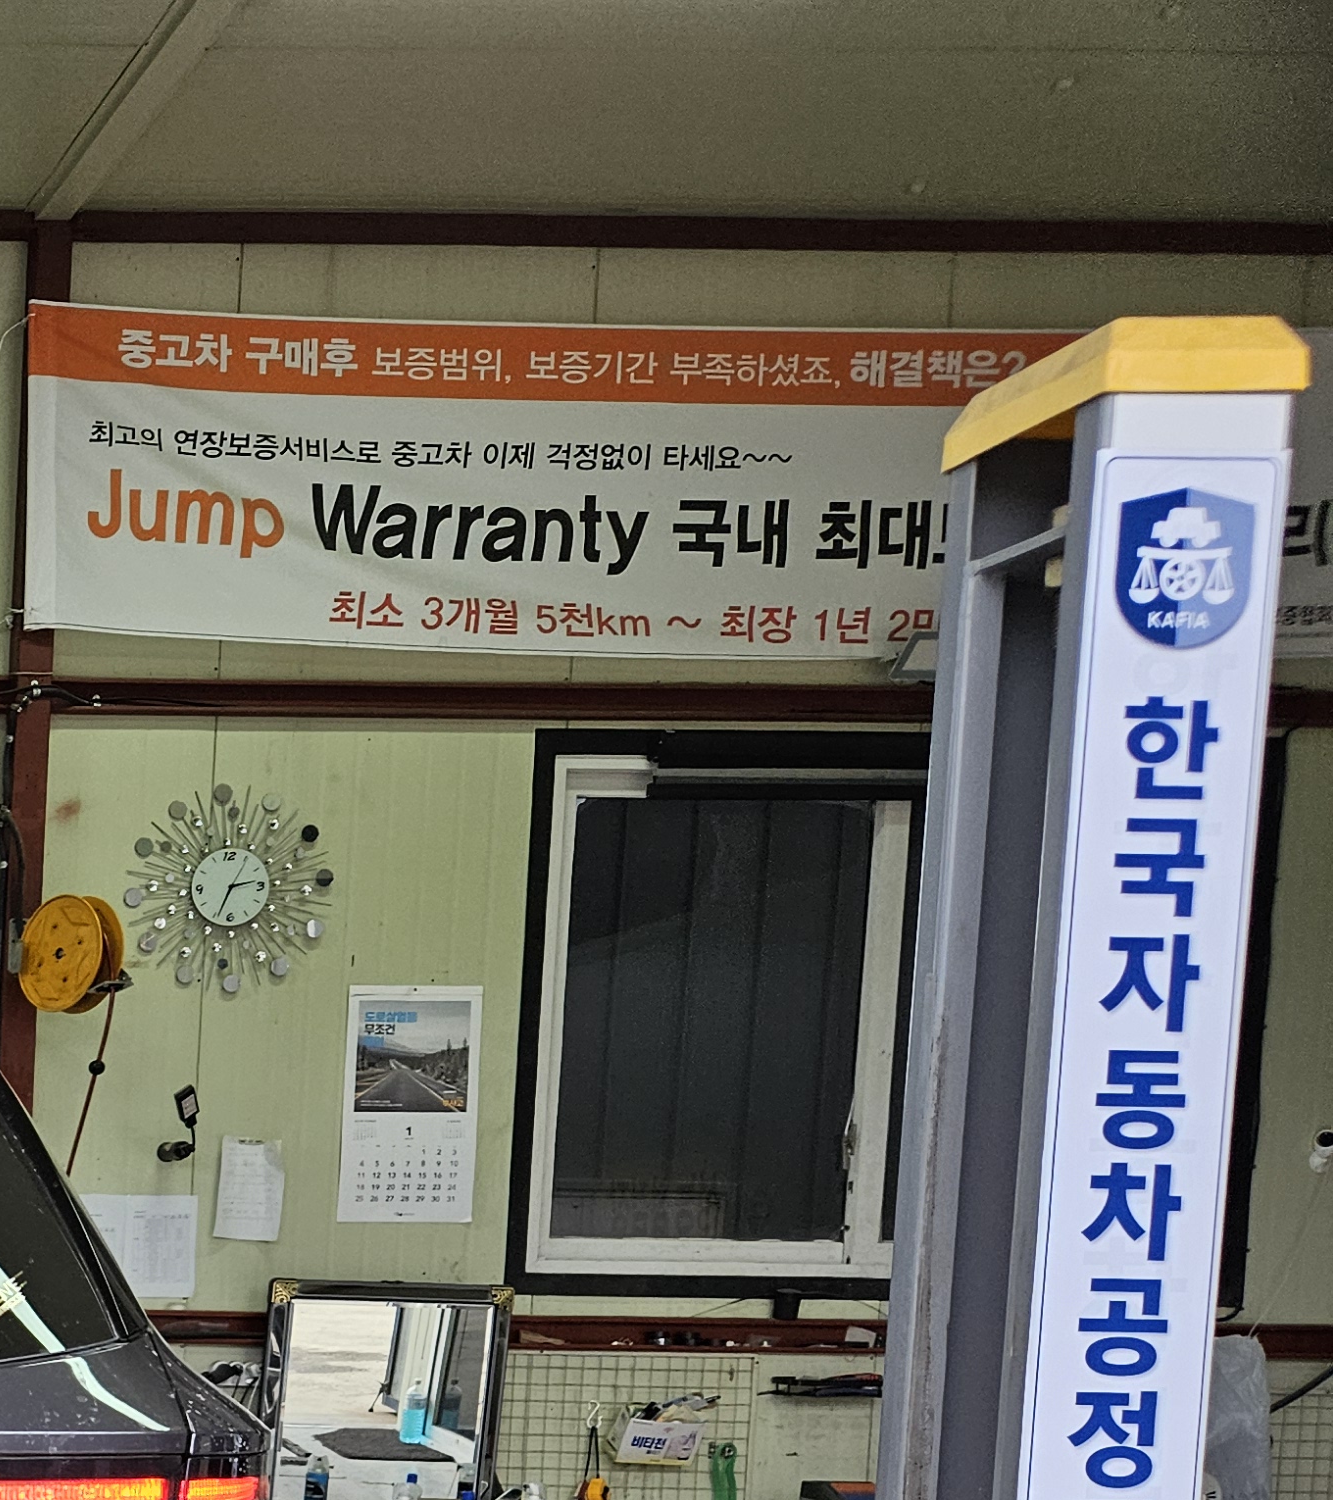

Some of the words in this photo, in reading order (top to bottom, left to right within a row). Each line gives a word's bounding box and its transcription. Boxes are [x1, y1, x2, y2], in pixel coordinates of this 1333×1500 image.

[118, 329, 233, 372] 중고차
[245, 336, 359, 377] 구매후
[371, 347, 511, 383] 보증범위,
[525, 350, 658, 384] 보증기간
[669, 352, 840, 389] 부족하셨죠,
[88, 420, 163, 452] 최고의
[173, 429, 382, 464] 연장보증서비스로
[391, 440, 473, 469] 중고차
[483, 441, 536, 470] 이제
[546, 442, 652, 471] 걱정없이
[87, 468, 285, 559] Jump
[311, 483, 650, 576] Warranty
[672, 498, 790, 569] 국내
[329, 591, 404, 630] 최소
[421, 596, 518, 635] 3개월
[536, 602, 651, 638] 5천km
[720, 605, 798, 644] 최장
[814, 606, 872, 645] 1년
[1148, 611, 1210, 630] KAFIA
[223, 852, 236, 861] 12
[196, 884, 203, 894] 9
[256, 882, 264, 891] 3
[226, 913, 234, 922] 6
[405, 1126, 412, 1136] 1
